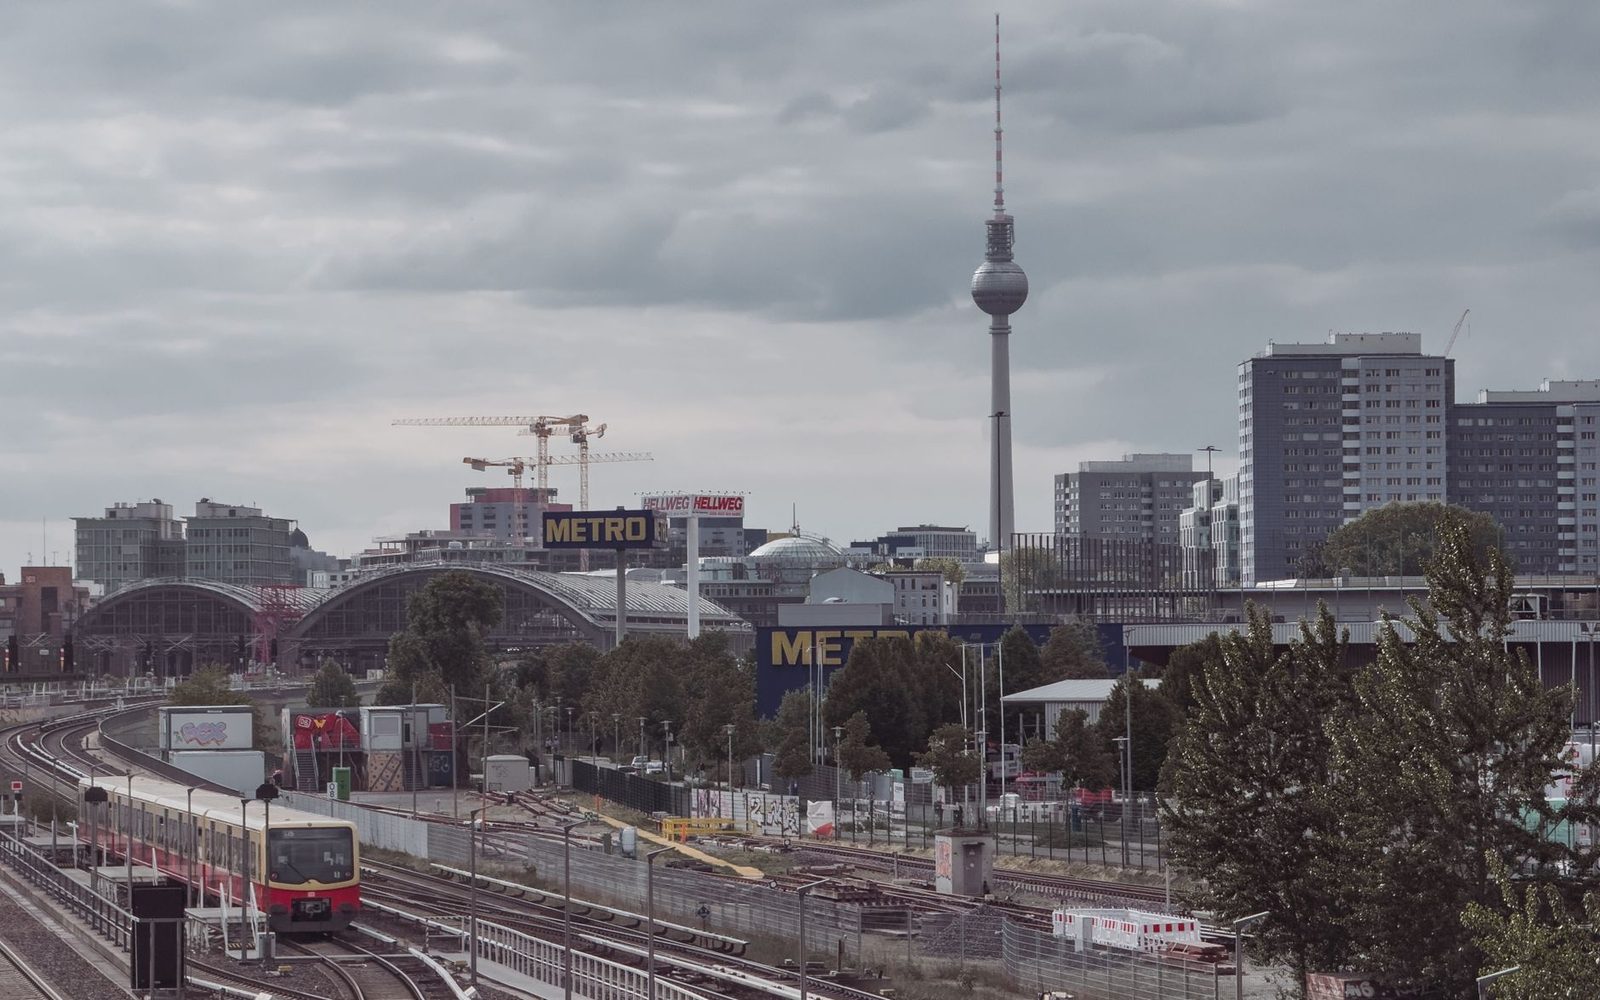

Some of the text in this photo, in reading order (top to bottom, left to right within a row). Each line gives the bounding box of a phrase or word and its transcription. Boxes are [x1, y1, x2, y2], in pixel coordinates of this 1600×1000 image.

[643, 496, 690, 510] HELLWEG
[693, 496, 743, 510] HELLWEG
[546, 517, 646, 542] METRO
[771, 630, 950, 665] MET
